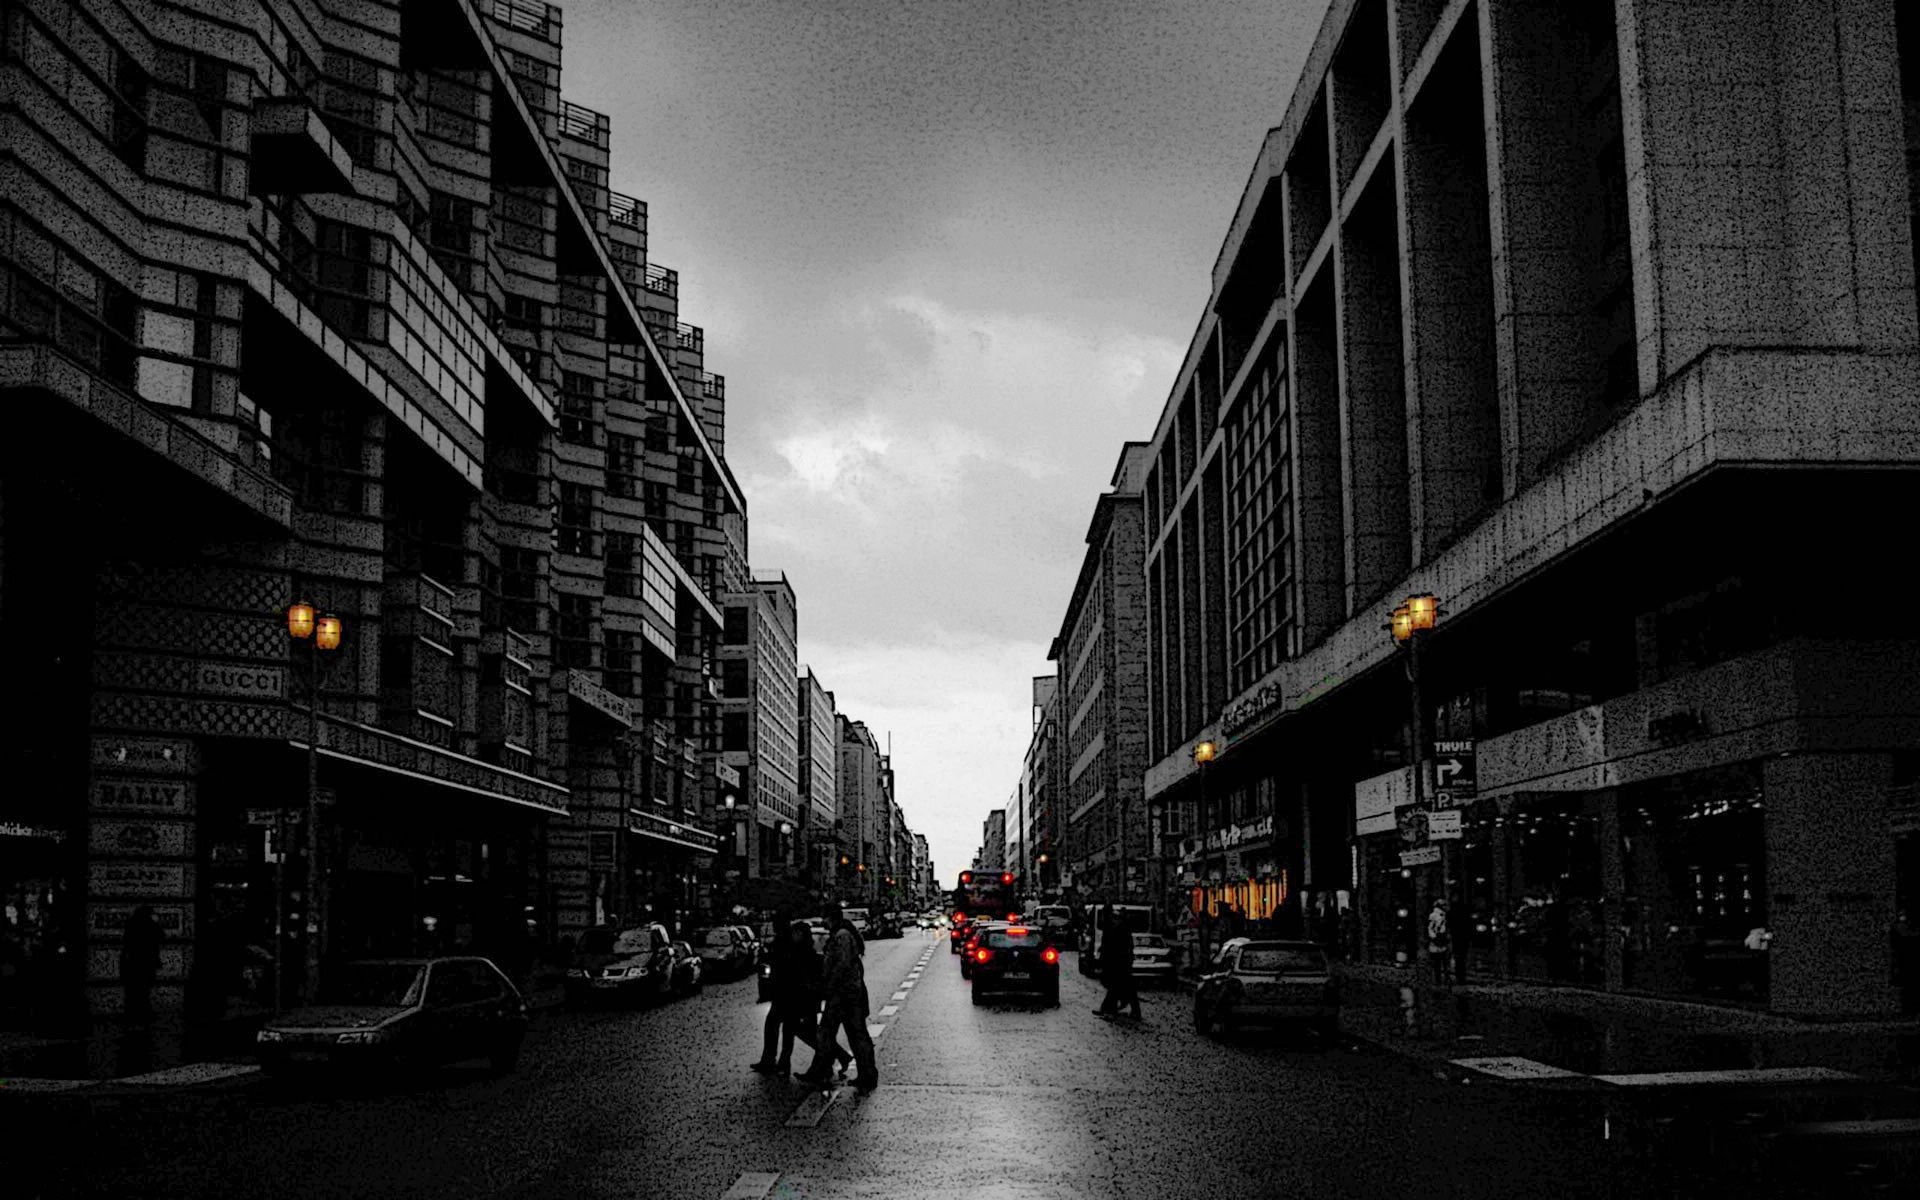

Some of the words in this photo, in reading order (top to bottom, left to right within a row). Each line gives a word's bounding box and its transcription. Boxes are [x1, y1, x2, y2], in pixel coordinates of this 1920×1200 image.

[203, 670, 279, 691] GUCCI
[1433, 741, 1472, 752] THULE
[100, 784, 177, 806] BALLY
